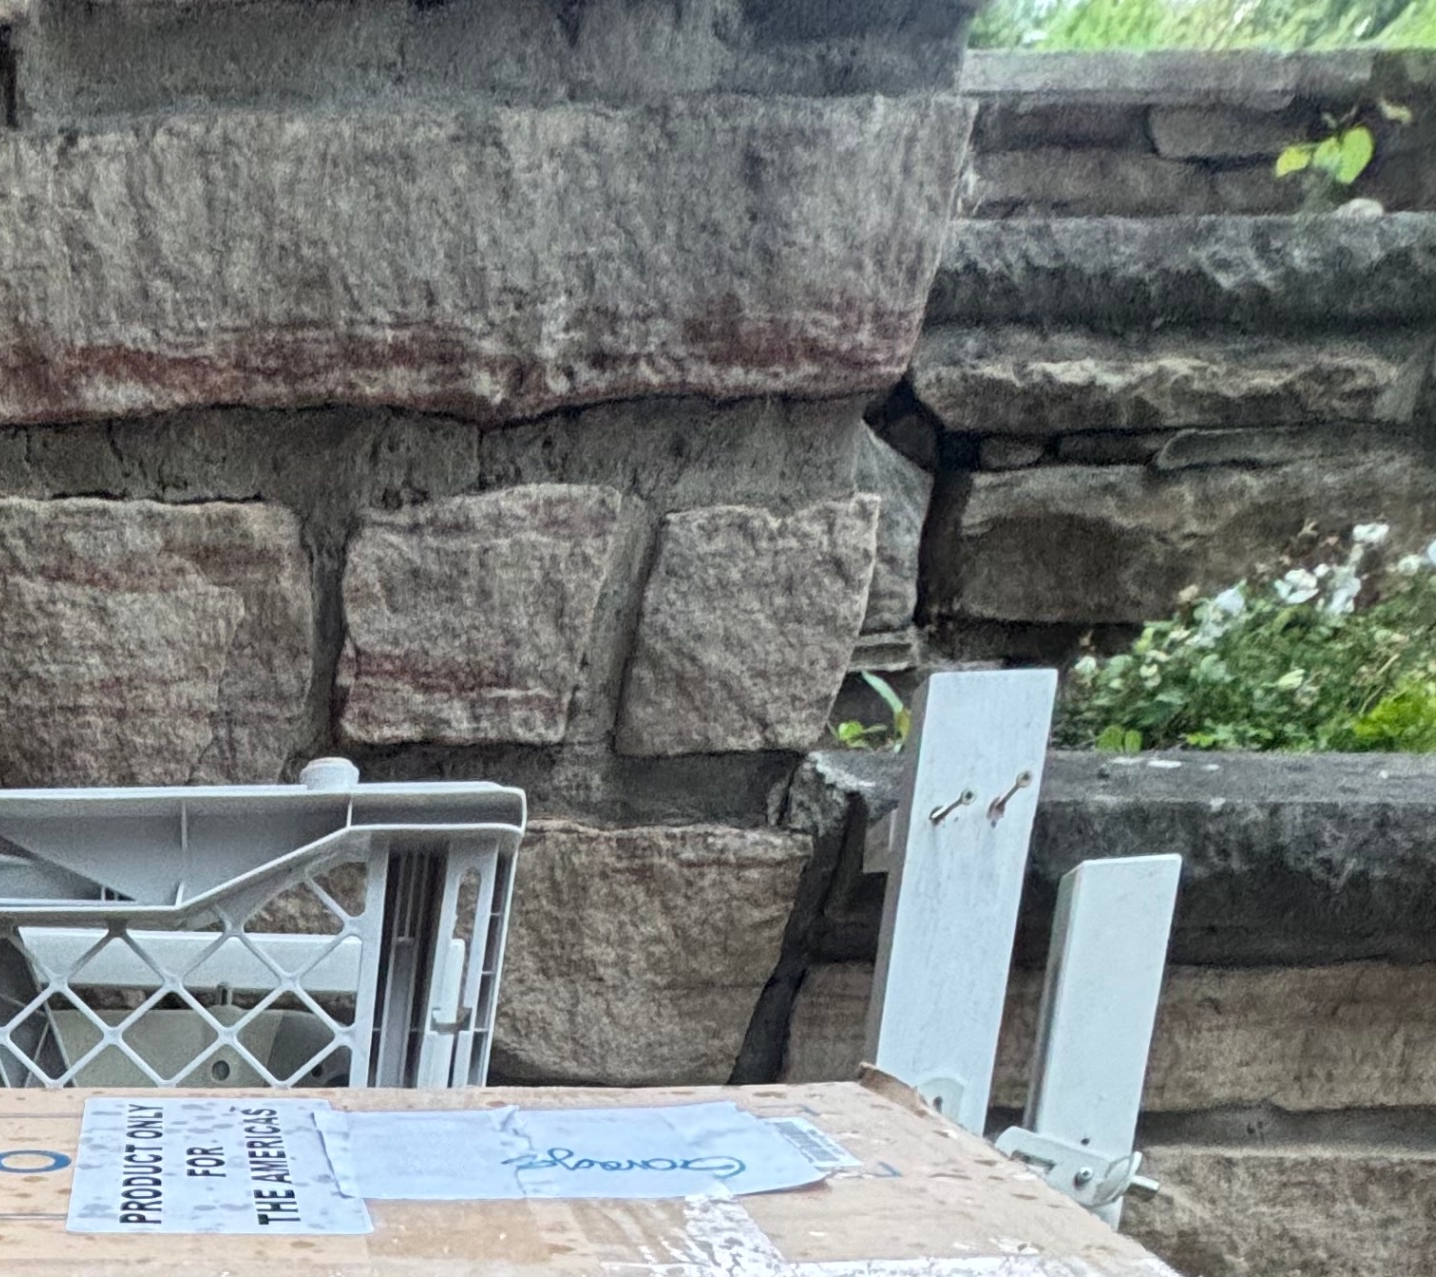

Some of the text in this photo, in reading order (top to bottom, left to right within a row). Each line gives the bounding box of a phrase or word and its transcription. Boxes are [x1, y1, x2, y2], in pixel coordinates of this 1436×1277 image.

[119, 1104, 163, 1224] PRODUCT ONLY
[186, 1146, 227, 1177] FOR
[241, 1108, 301, 1225] THE AMERICAS
